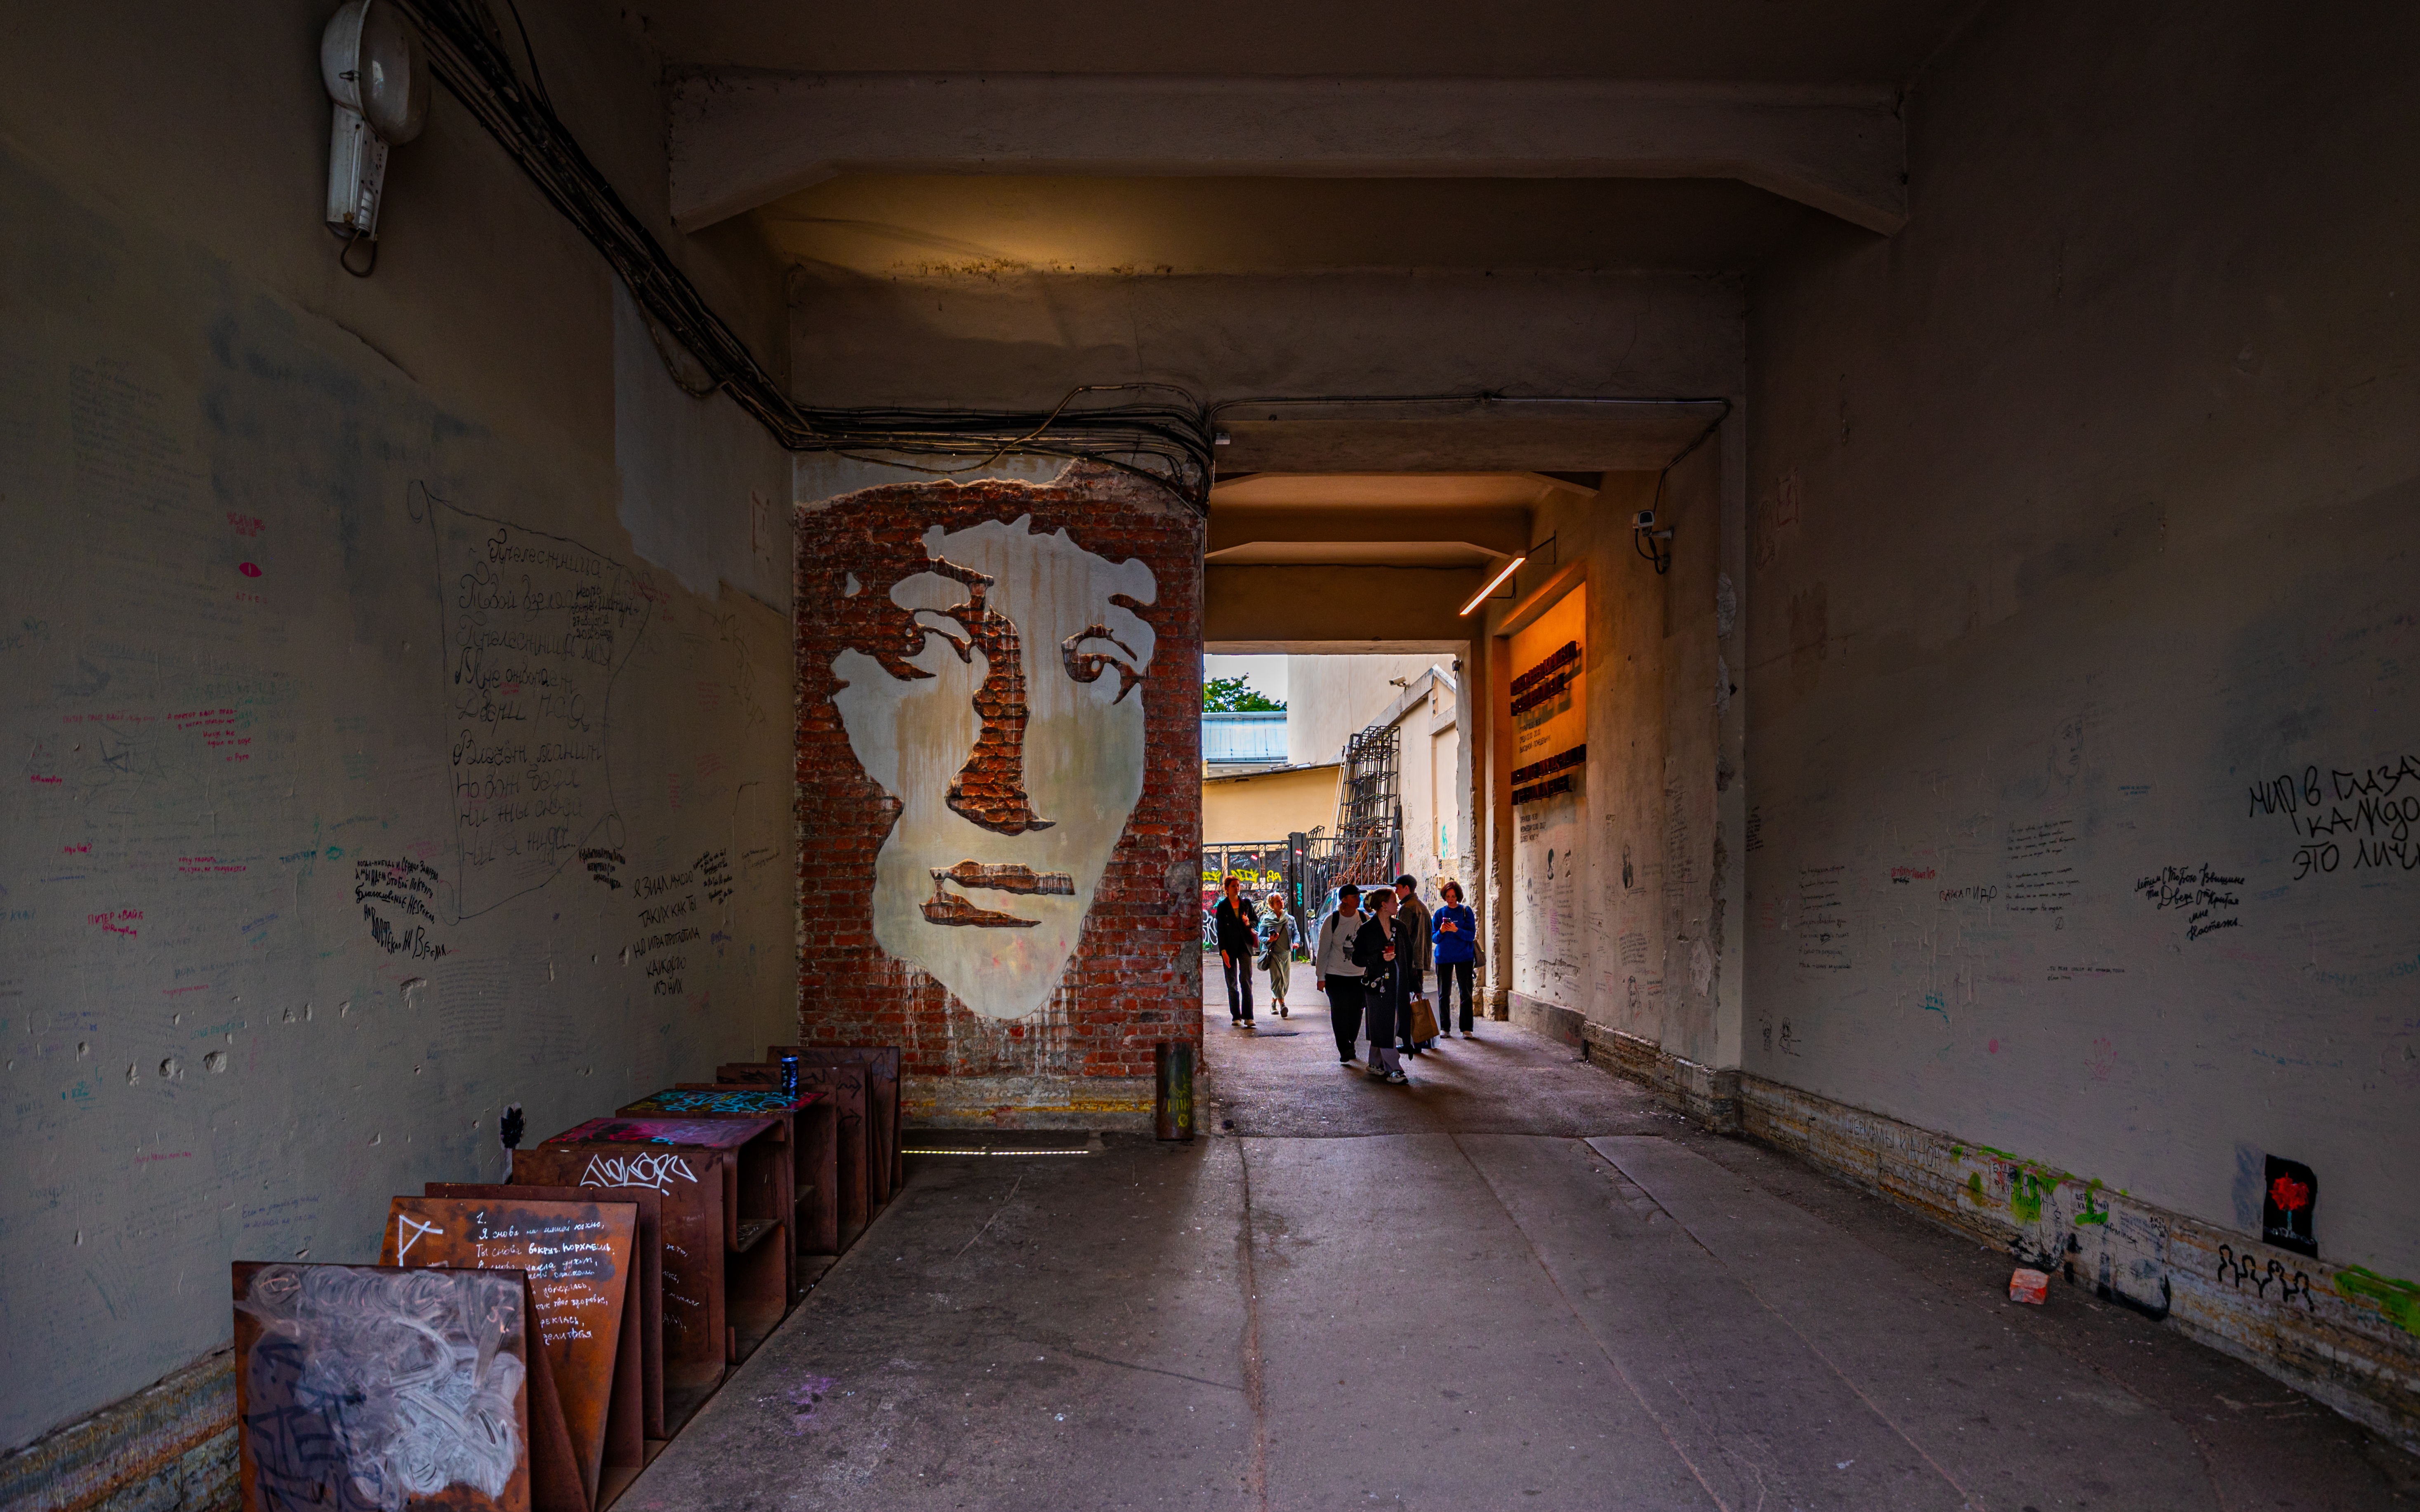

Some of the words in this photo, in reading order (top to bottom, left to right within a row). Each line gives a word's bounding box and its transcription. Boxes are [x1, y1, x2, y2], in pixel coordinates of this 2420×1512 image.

[2250, 775, 2300, 835] МИР
[2305, 765, 2321, 806] В
[2333, 756, 2420, 800] ГЛАЗА
[2293, 841, 2339, 880] ЭТО
[2354, 838, 2420, 869] ЛИЧ
[639, 905, 669, 928] ТАКИХ
[671, 901, 686, 917] КАК
[634, 938, 646, 959] НО
[654, 980, 666, 995] ИЗ
[668, 978, 683, 995] НИХ
[479, 1228, 489, 1240] Я
[492, 1225, 519, 1239] снова
[476, 1244, 489, 1258] Ты
[492, 1244, 522, 1257] снова
